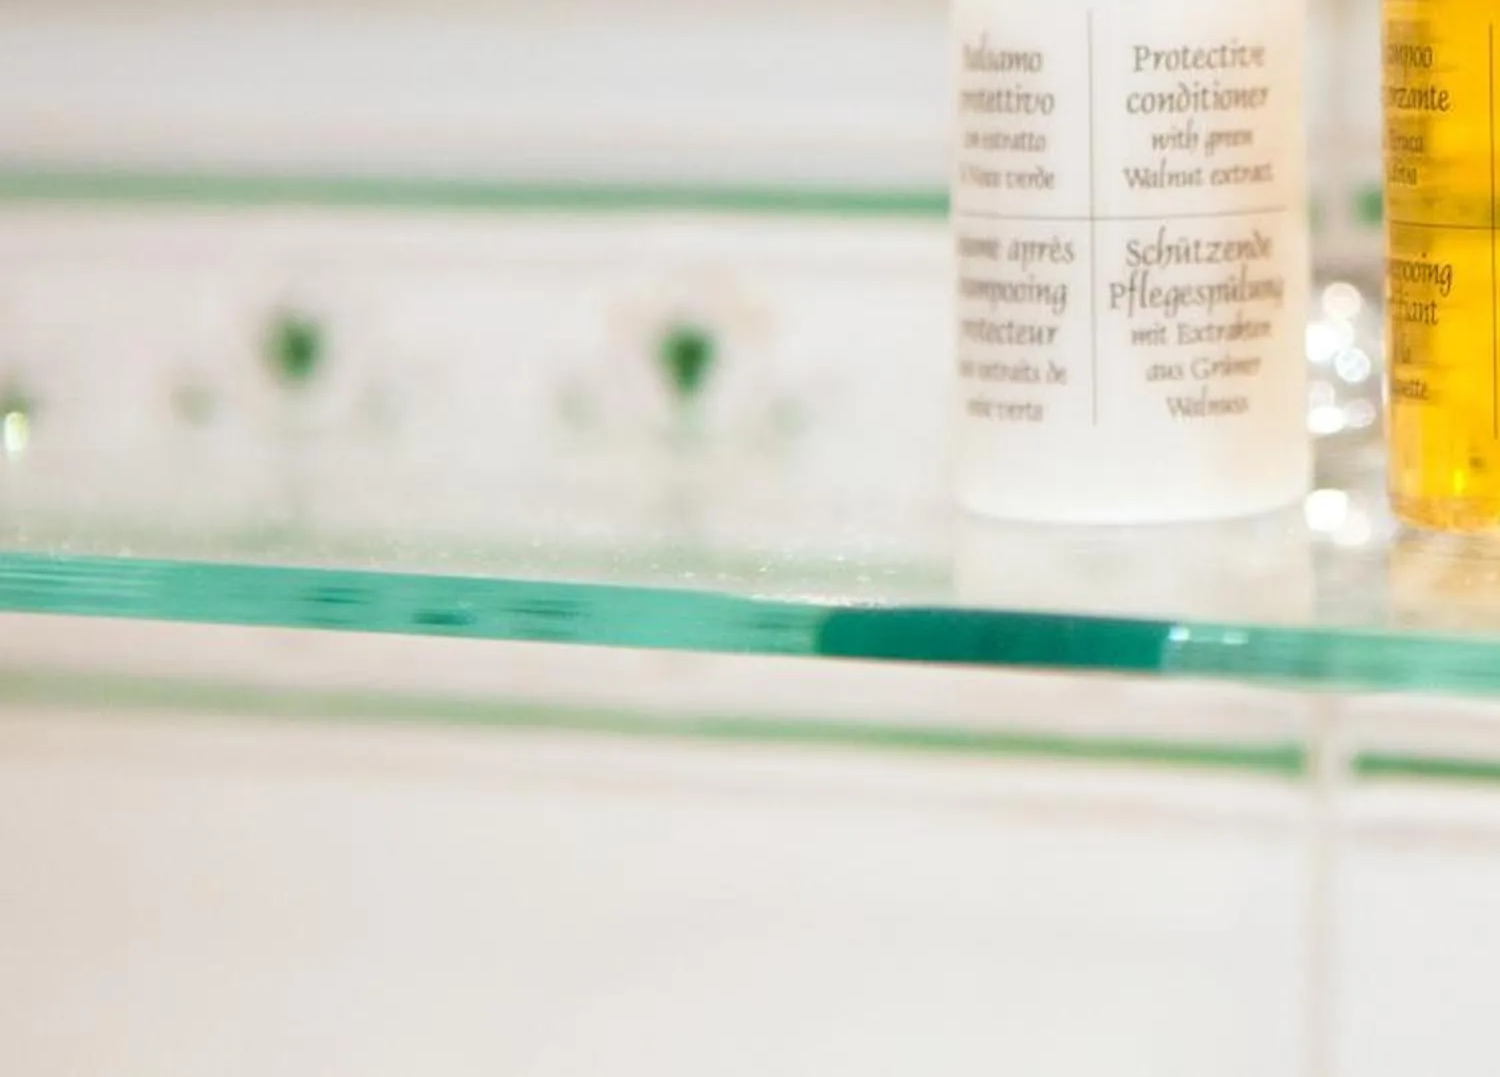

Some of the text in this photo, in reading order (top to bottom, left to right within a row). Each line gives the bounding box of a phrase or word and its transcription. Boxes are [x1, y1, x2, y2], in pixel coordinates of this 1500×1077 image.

[1132, 37, 1268, 74] Protective
[1125, 80, 1271, 117] conditioner
[1151, 117, 1200, 152] with
[1130, 320, 1170, 347] mit
